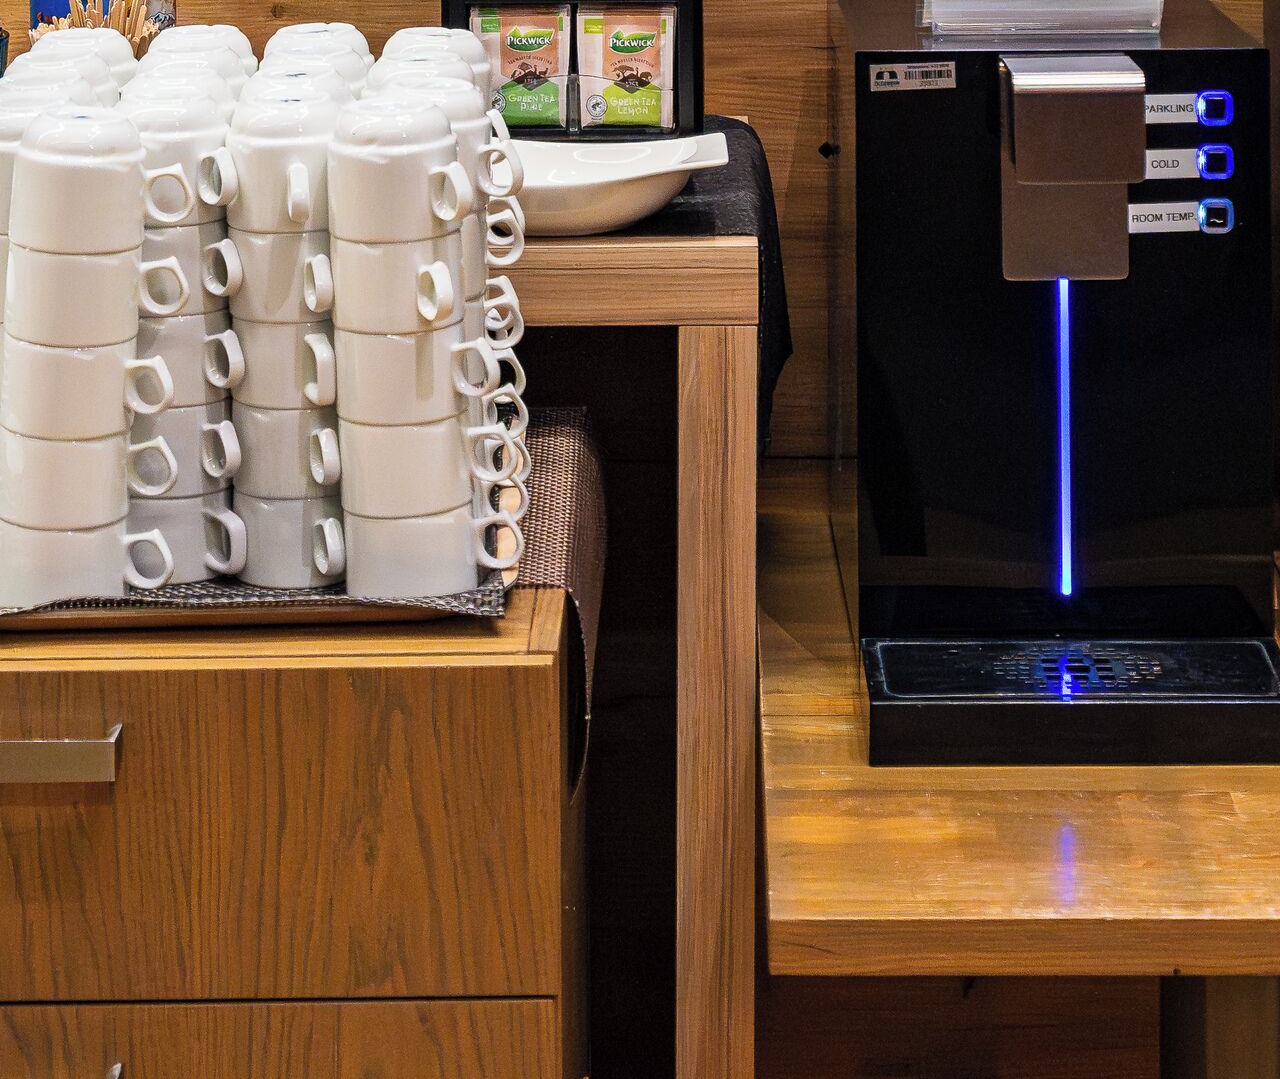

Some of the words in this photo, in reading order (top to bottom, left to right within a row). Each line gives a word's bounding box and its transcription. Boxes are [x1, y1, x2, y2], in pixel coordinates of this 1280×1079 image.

[508, 36, 551, 45] PICKWICK
[610, 38, 653, 47] PICKWICK
[508, 94, 539, 102] GREEN
[540, 94, 555, 102] TEA
[611, 97, 640, 107] GREEN
[1145, 104, 1194, 113] PARKLING
[1151, 160, 1179, 168] COLD
[1132, 214, 1163, 223] ROOM
[1166, 212, 1197, 221] TEMP.
